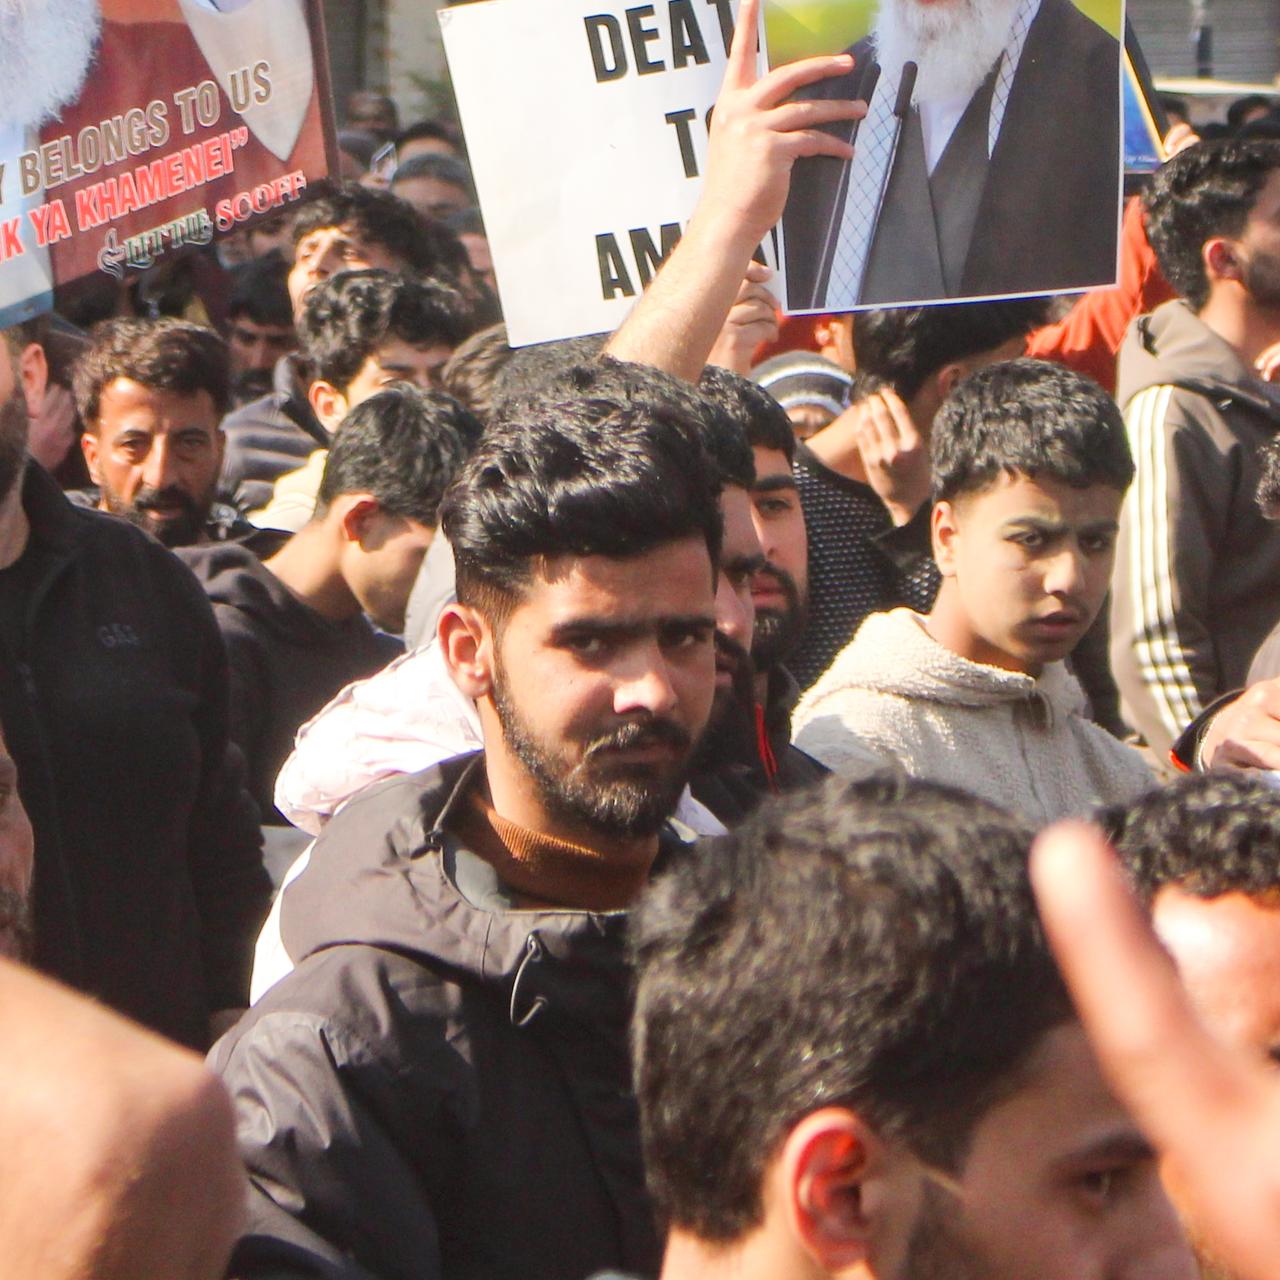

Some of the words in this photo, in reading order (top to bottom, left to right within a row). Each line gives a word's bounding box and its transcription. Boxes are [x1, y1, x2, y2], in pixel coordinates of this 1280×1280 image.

[17, 99, 170, 198] BELONGS
[173, 79, 221, 135] TO
[227, 59, 273, 114] US
[28, 198, 73, 248] YA
[74, 125, 249, 232] KHAMENEI”
[665, 102, 716, 180] T
